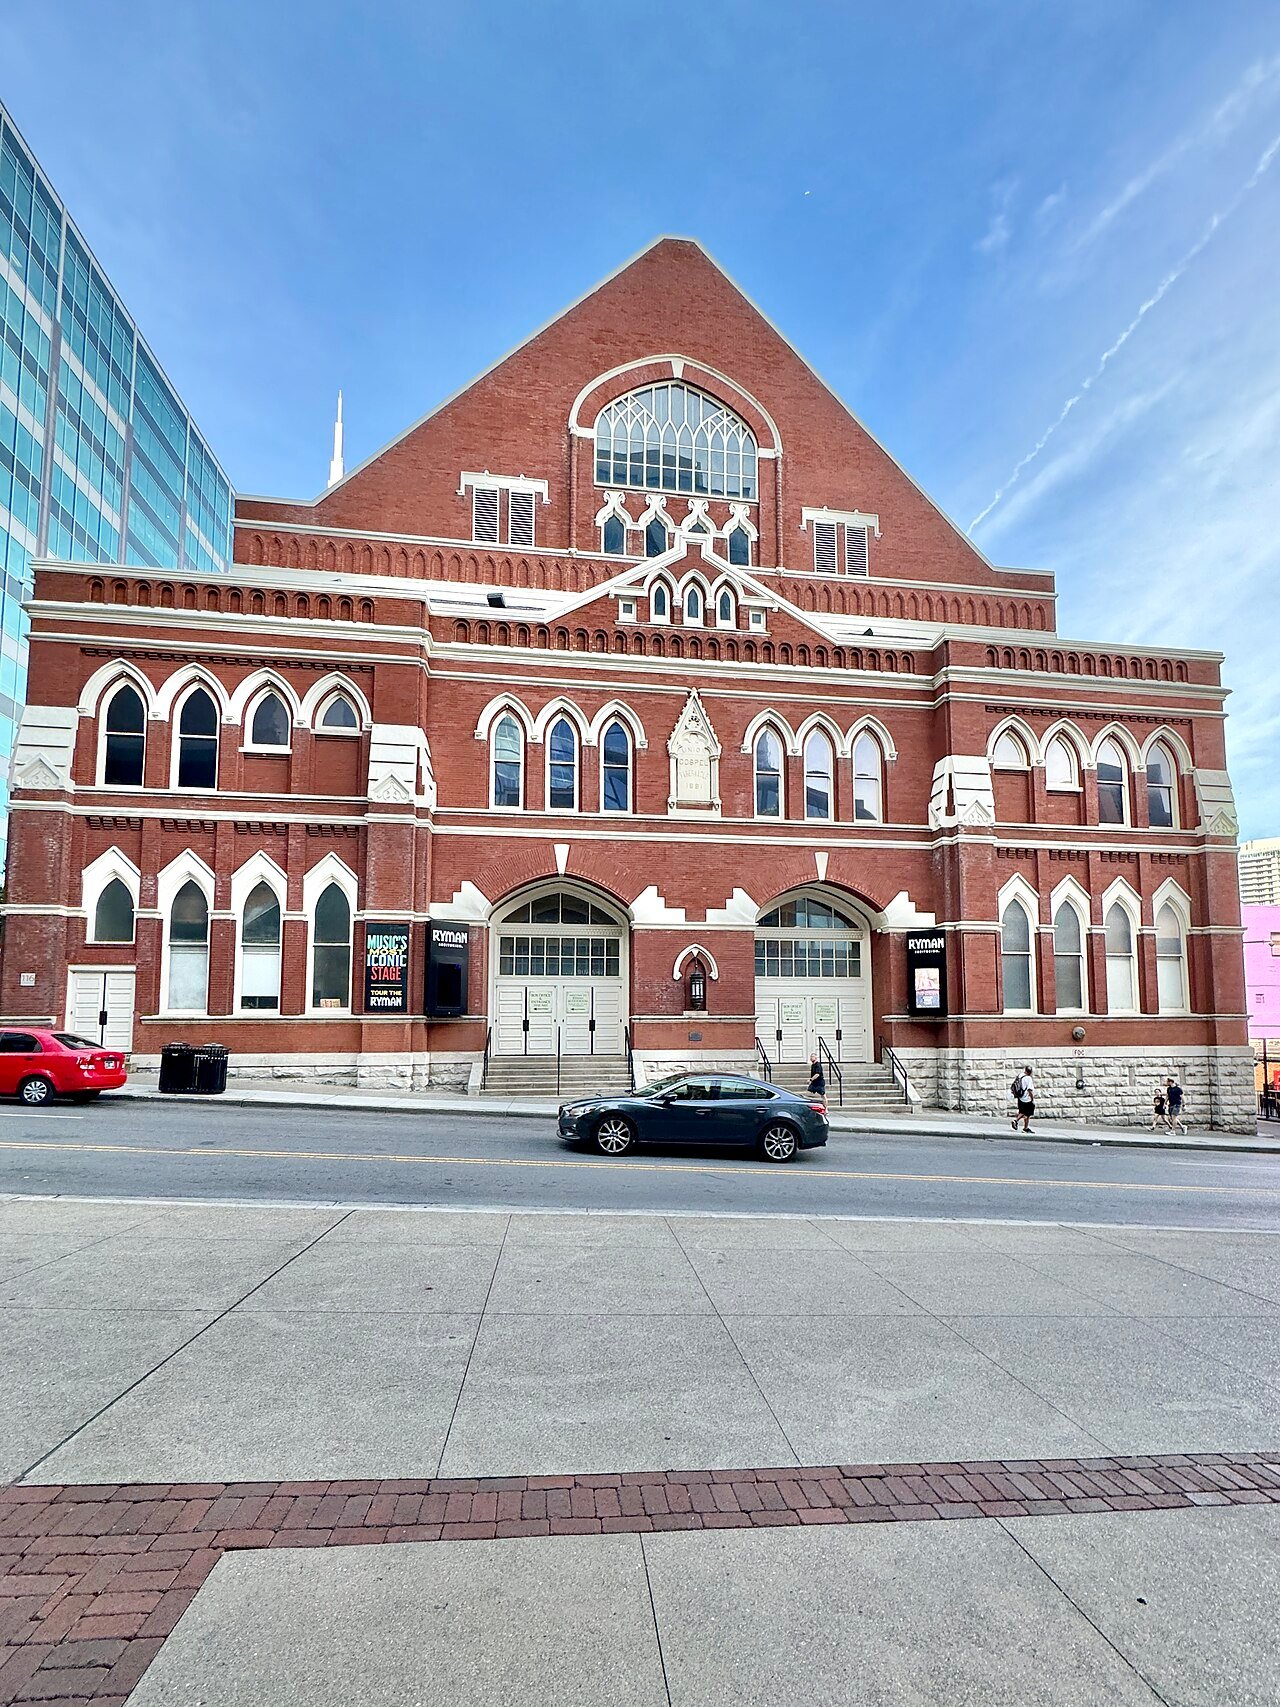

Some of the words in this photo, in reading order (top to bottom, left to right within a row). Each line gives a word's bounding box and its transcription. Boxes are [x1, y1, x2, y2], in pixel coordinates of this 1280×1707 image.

[367, 934, 408, 950] MUSIC'S
[433, 929, 468, 944] RYMAN
[908, 937, 945, 950] RYMAN
[366, 955, 407, 967] ICONIC
[22, 974, 35, 982] 116
[371, 966, 402, 980] STAGE
[370, 996, 402, 1007] RYMAN
